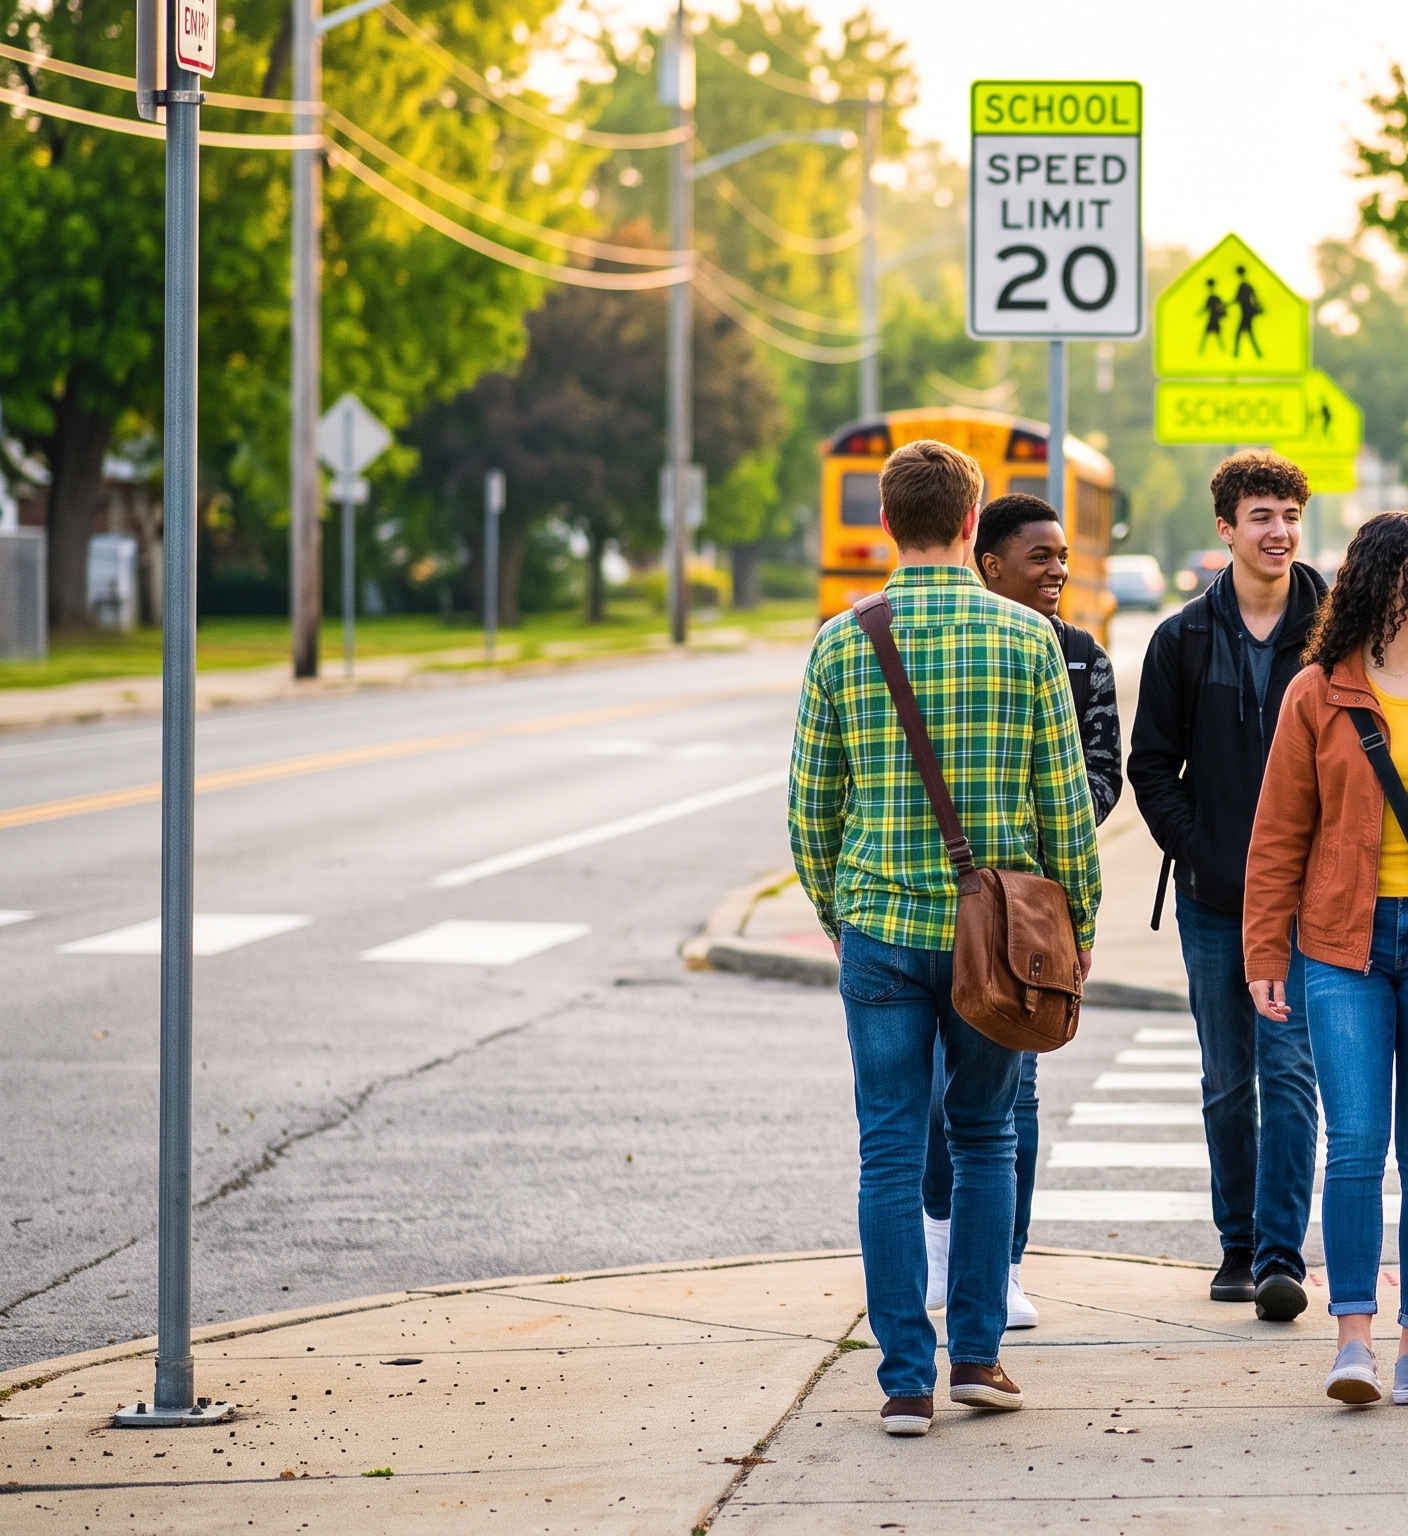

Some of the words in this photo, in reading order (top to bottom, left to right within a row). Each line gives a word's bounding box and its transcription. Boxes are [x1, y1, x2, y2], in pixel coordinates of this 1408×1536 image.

[984, 94, 1130, 125] SCHOOL
[987, 153, 1127, 185] SPEED
[1002, 199, 1111, 230] LIMIT
[996, 244, 1118, 313] 20
[1176, 398, 1288, 427] SCHOOL
